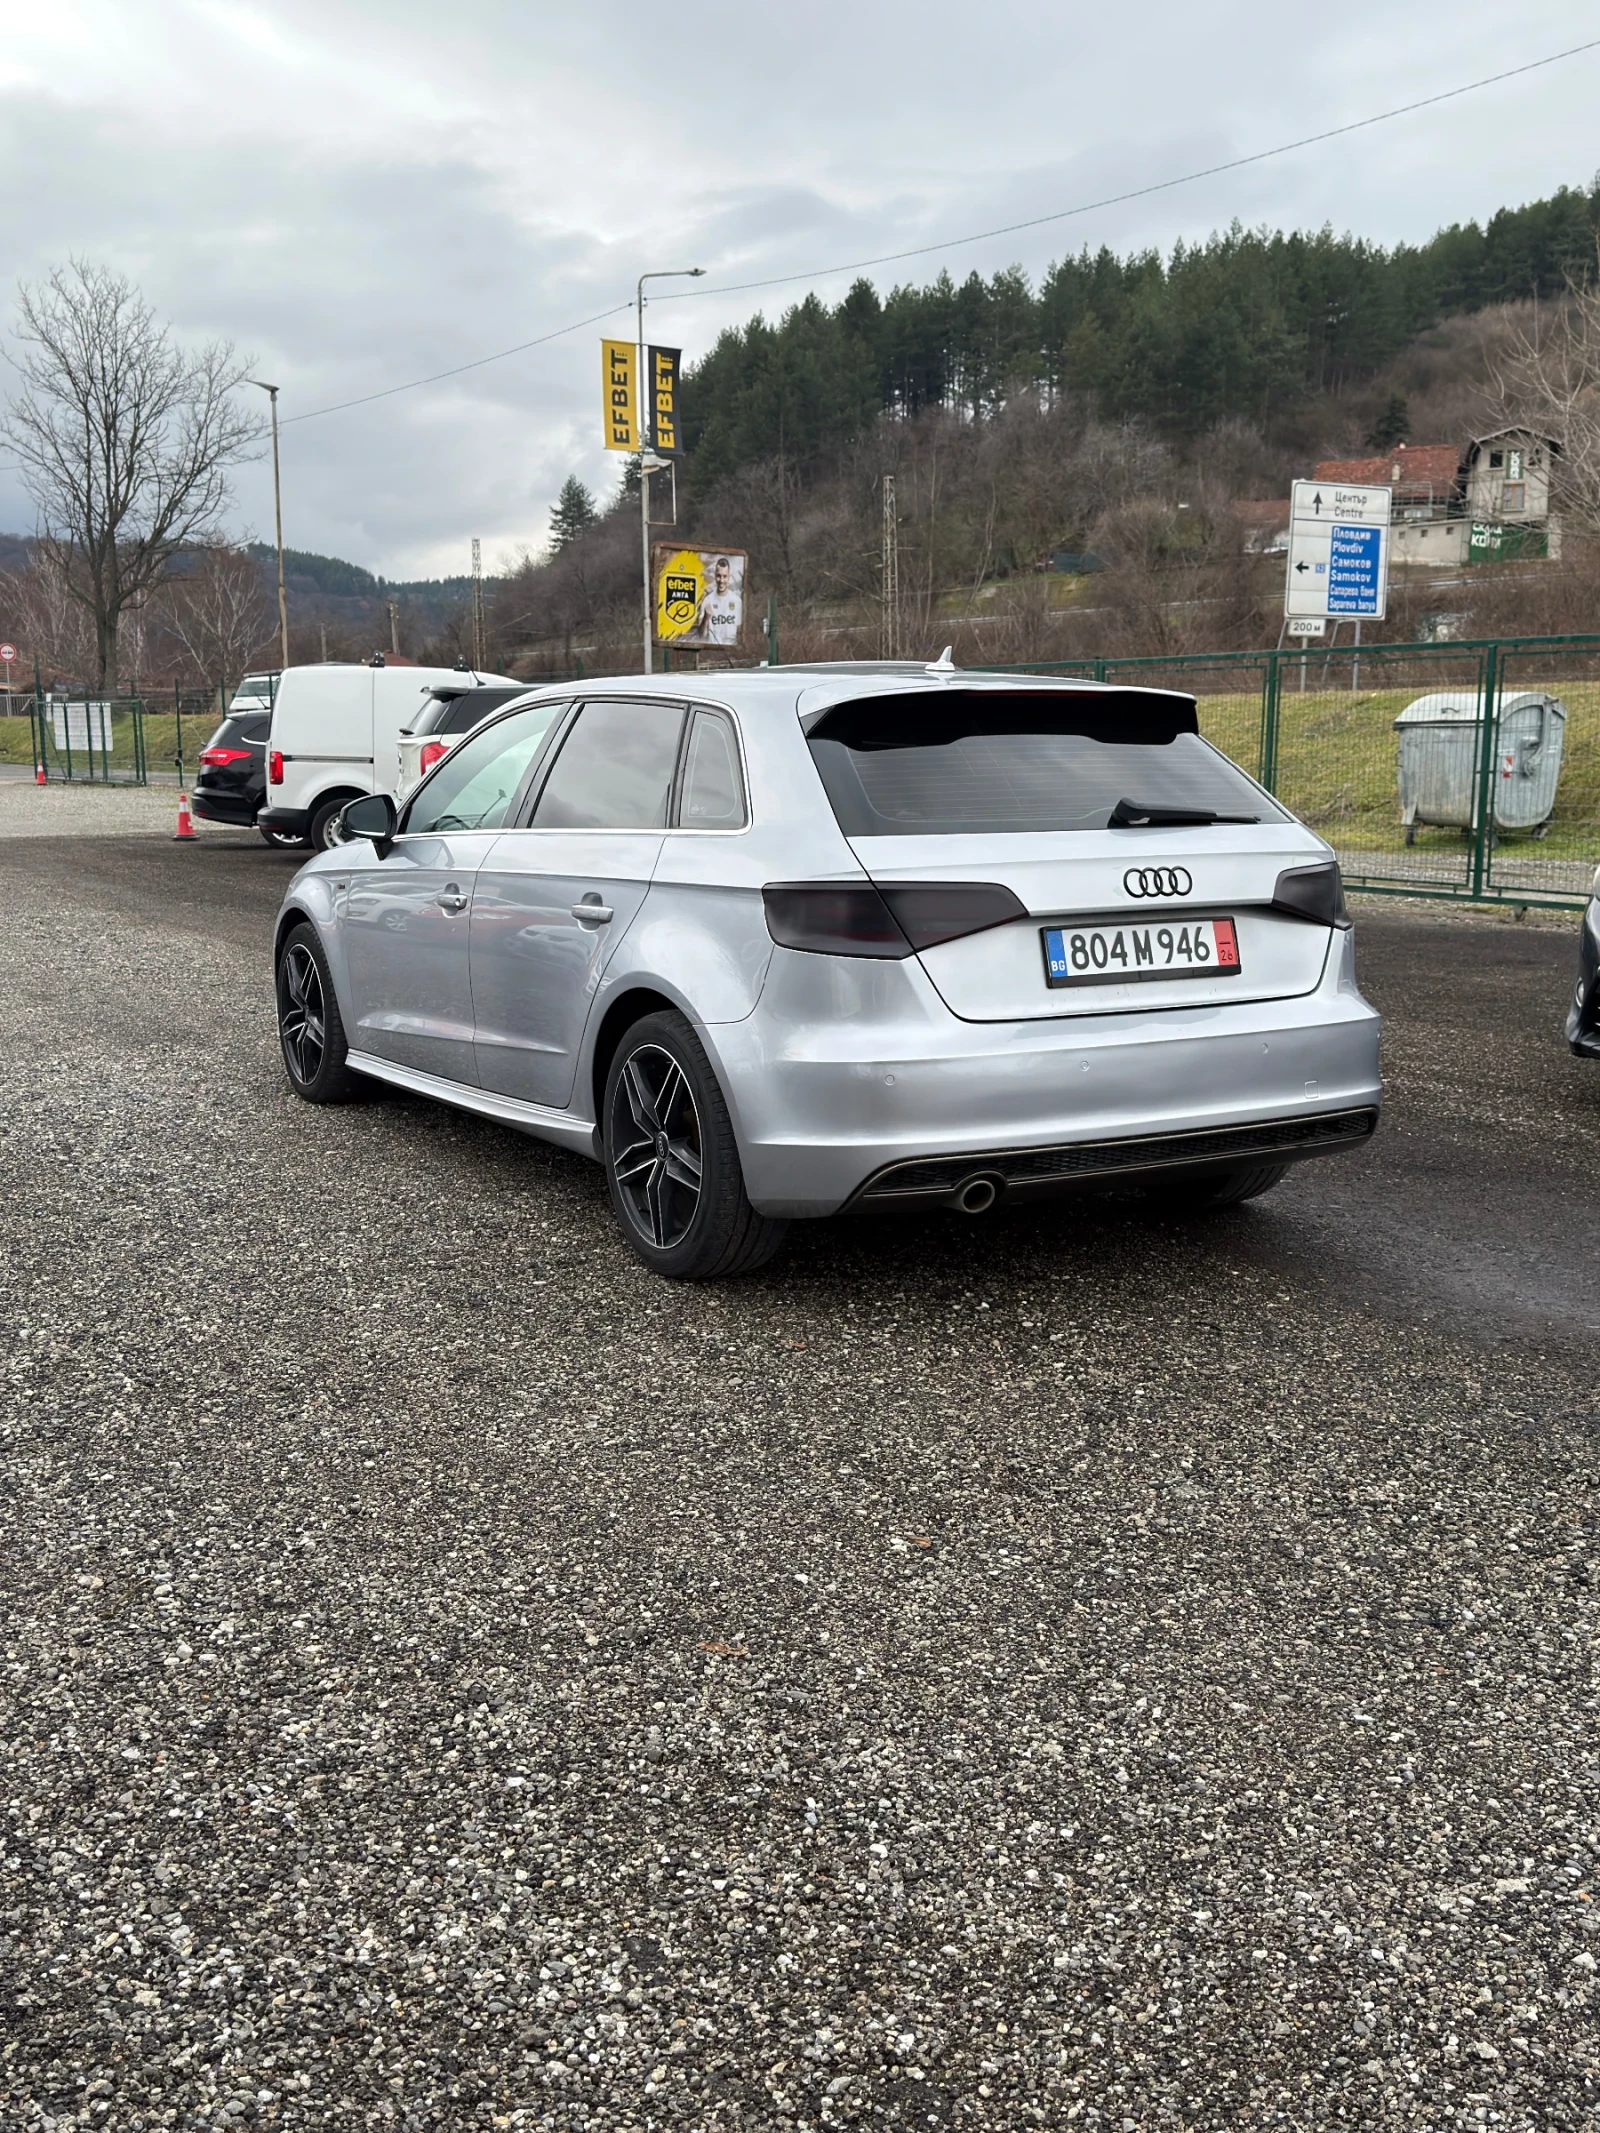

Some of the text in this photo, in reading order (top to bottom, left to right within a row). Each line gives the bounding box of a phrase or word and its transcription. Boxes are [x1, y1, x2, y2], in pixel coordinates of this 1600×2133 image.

[611, 348, 630, 444] EFBET
[656, 352, 675, 448] EFBET
[1335, 491, 1367, 506] Център
[1334, 506, 1363, 518] Centre
[1333, 527, 1371, 541] Пловдив
[1332, 541, 1364, 553] Plovdiv
[1331, 556, 1371, 568] Самоков
[1330, 570, 1371, 582] Samokov
[667, 580, 694, 591] efbet
[1329, 598, 1376, 612] Sapareva banya
[711, 615, 736, 625] efbet
[1293, 622, 1313, 632] 200
[1220, 949, 1234, 961] 26
[1051, 960, 1066, 971] BG
